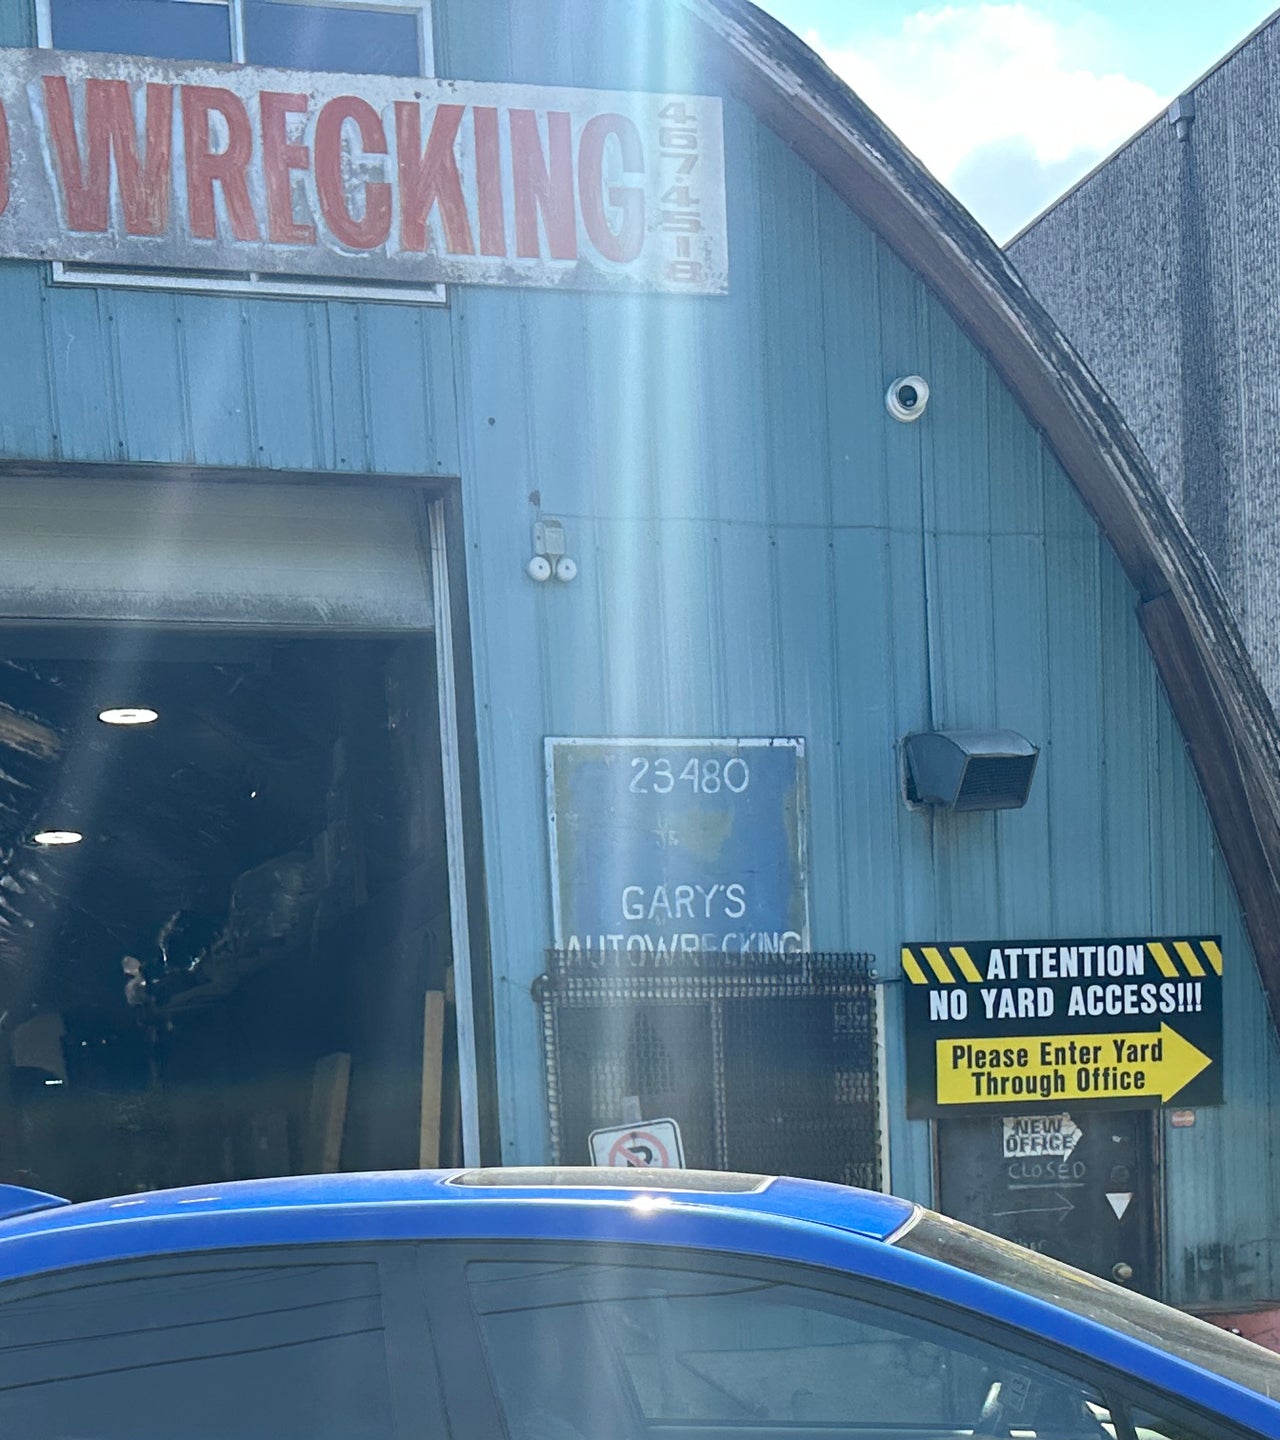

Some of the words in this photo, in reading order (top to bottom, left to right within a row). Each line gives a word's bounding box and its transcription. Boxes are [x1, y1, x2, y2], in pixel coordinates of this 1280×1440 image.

[41, 74, 647, 263] WRECKING
[628, 756, 751, 794] 23480
[622, 884, 747, 920] GARY'S
[986, 945, 1145, 980] ATTENTION
[929, 989, 968, 1021] NO
[980, 986, 1055, 1019] YARD
[1067, 982, 1203, 1017] ACCESS!!!
[952, 1044, 1029, 1070] Please
[1039, 1042, 1103, 1067] Enter
[1112, 1038, 1163, 1063] Yard
[970, 1069, 1066, 1098] Through
[1076, 1066, 1146, 1093] Office
[1016, 1118, 1063, 1135] NEW
[1006, 1135, 1074, 1153] OFFICE
[1008, 1161, 1086, 1180] CLOSED
